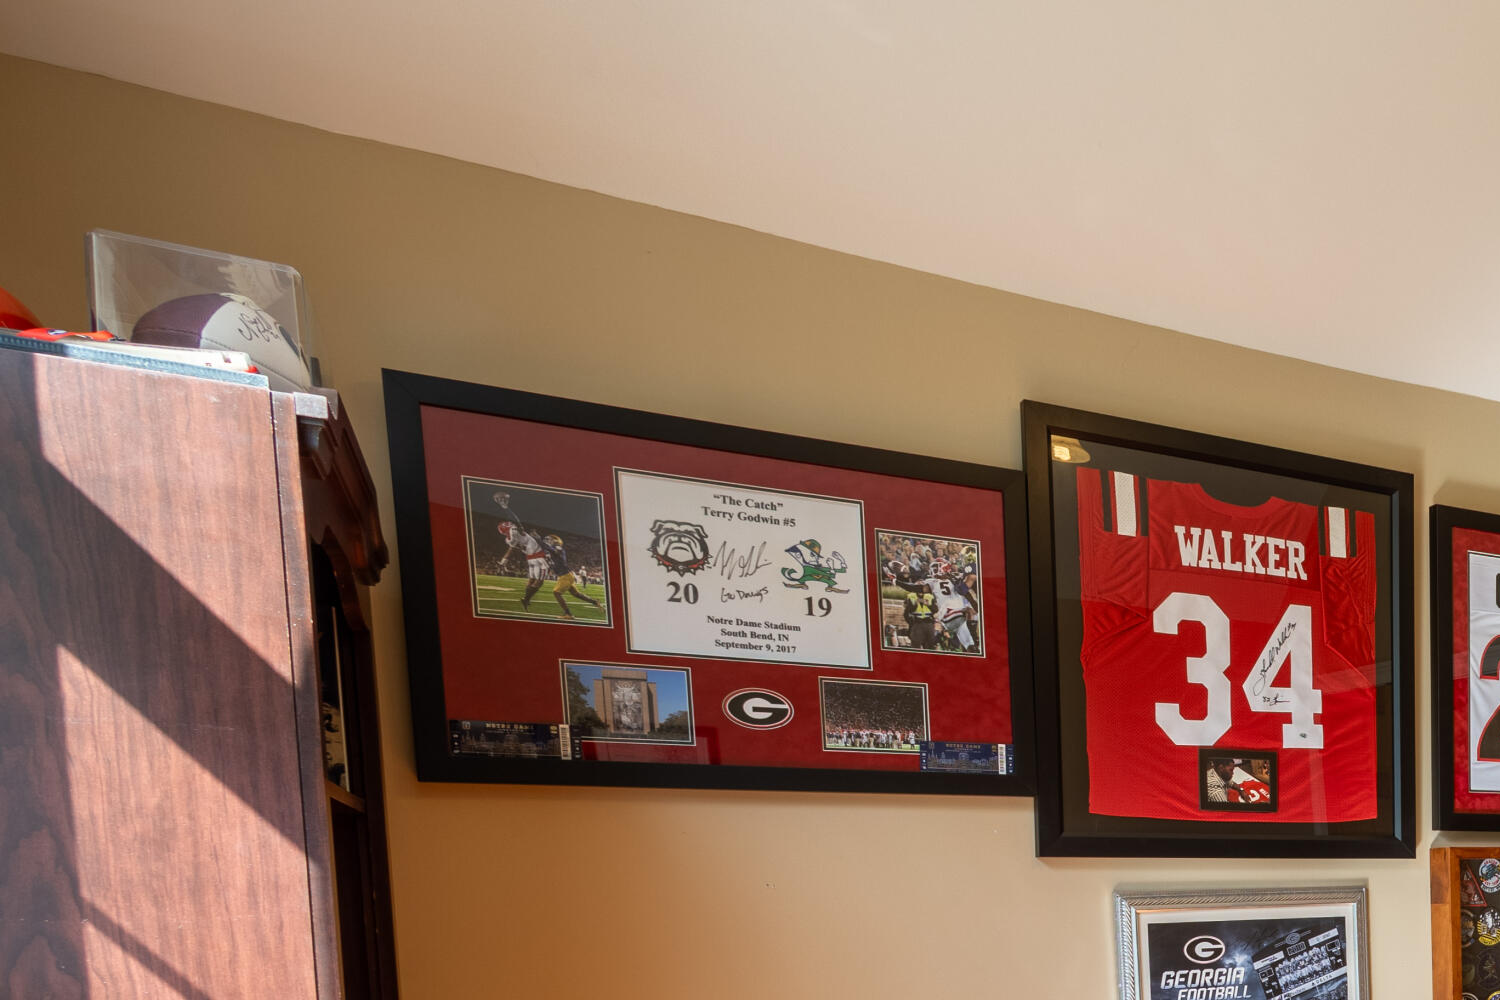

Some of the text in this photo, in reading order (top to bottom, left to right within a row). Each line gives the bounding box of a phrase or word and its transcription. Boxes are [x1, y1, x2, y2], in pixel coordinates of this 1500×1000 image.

[701, 506, 796, 528] Terry Godwin #5
[1174, 525, 1308, 581] WALKER
[666, 581, 699, 604] 20
[940, 581, 951, 595] 5
[804, 596, 832, 618] 19
[707, 615, 801, 632] Notre Dame Stadium
[714, 639, 796, 653] September 9, 2017
[721, 628, 789, 642] South Bend, IN
[1153, 592, 1324, 749] 34
[724, 688, 793, 729] G
[1185, 936, 1225, 964] G
[1160, 967, 1246, 990] GEORGIA
